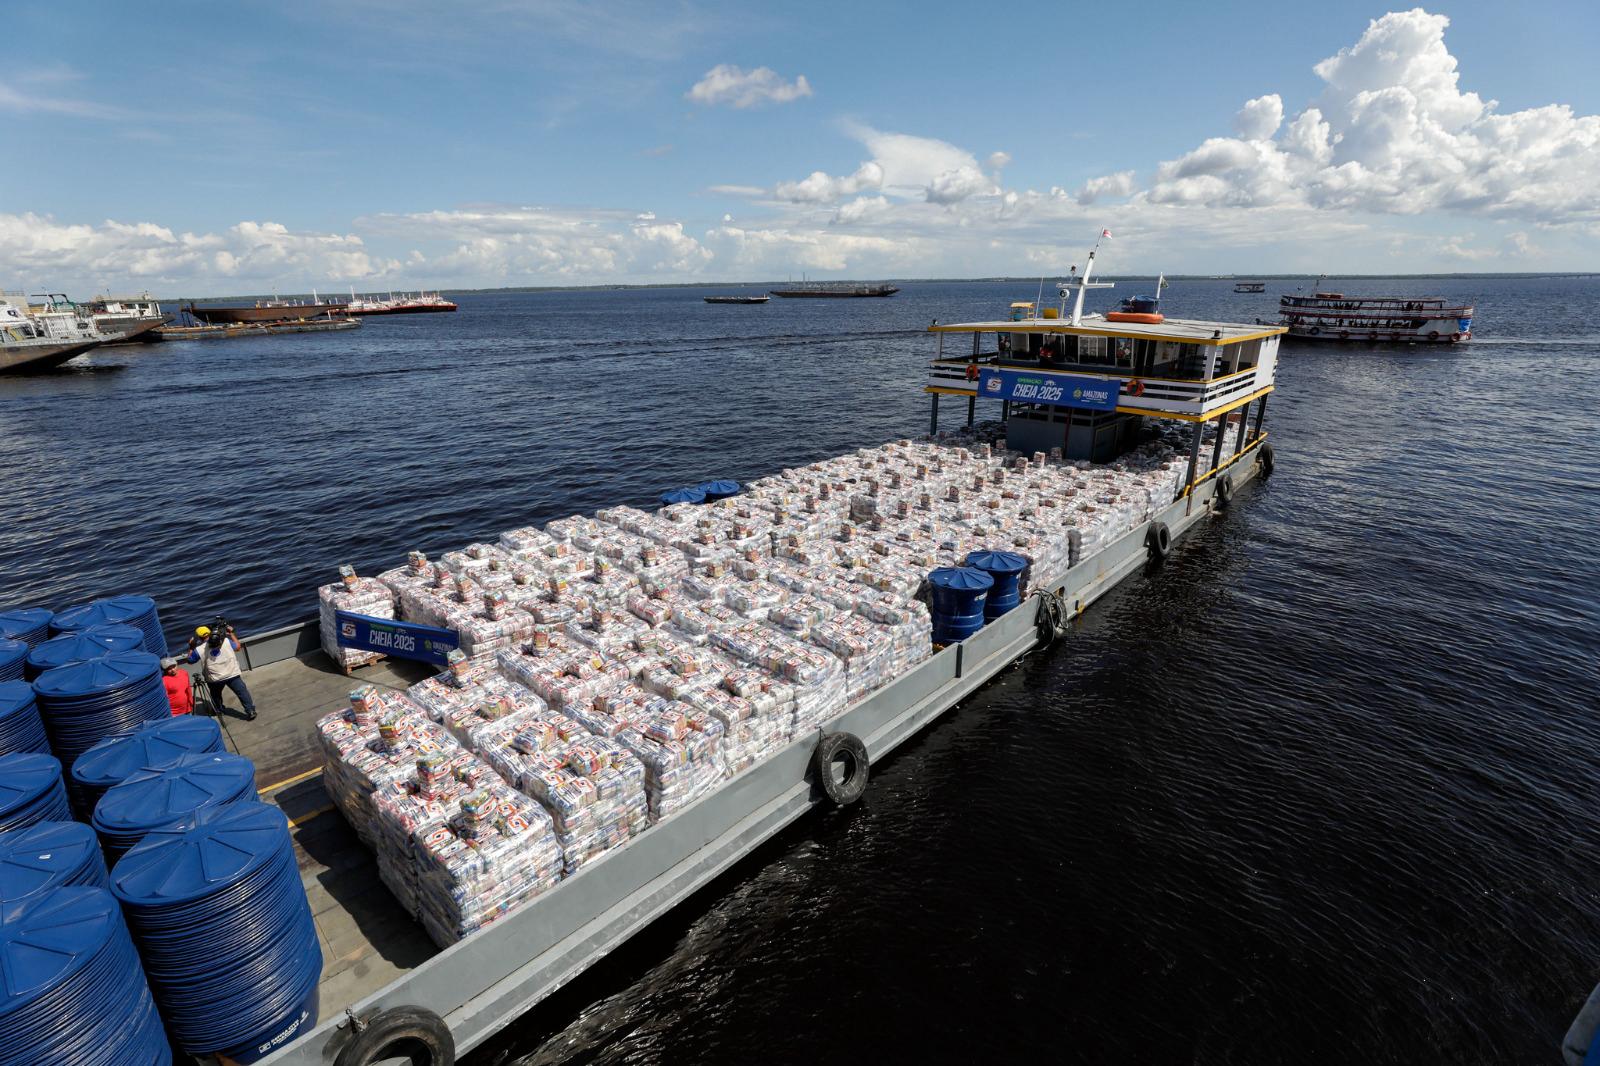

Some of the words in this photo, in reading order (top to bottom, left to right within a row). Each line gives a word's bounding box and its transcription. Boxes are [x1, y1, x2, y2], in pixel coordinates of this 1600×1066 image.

[1012, 384, 1039, 398] CHEIA
[1037, 386, 1064, 400] 2025
[369, 629, 393, 647] CHEIA
[394, 634, 415, 651] 2025
